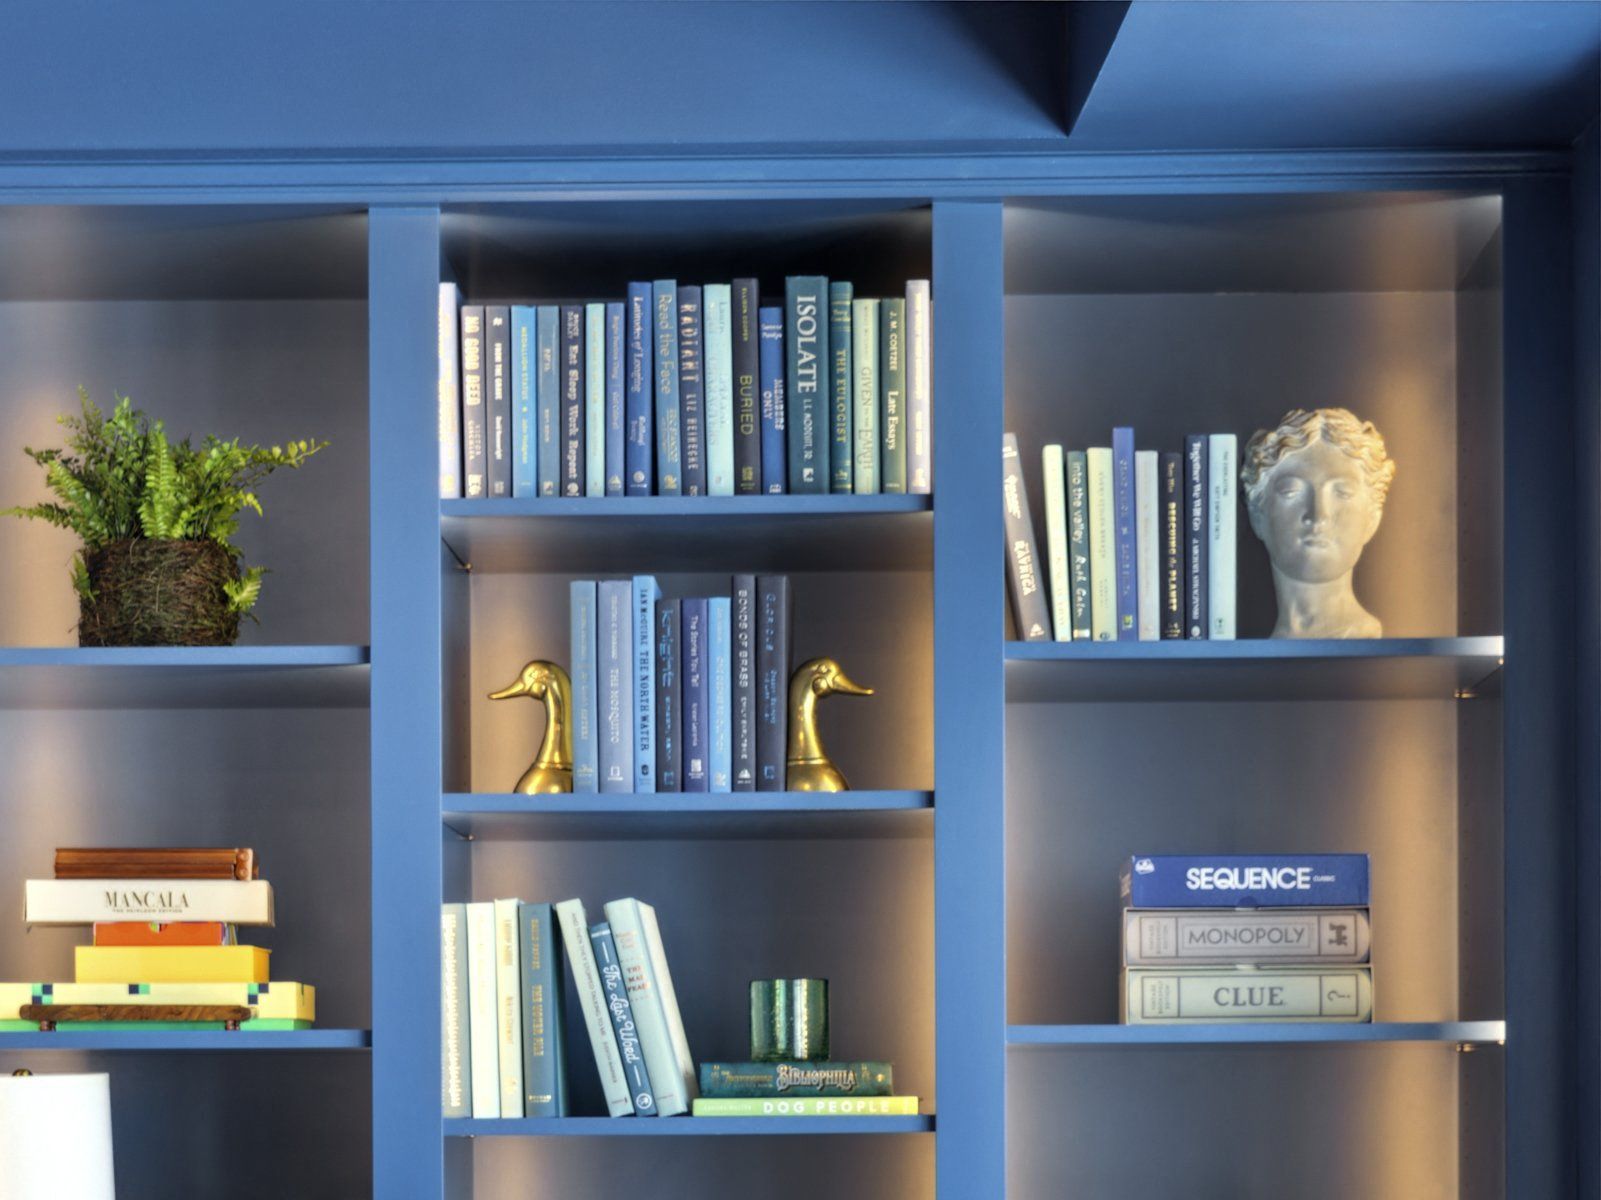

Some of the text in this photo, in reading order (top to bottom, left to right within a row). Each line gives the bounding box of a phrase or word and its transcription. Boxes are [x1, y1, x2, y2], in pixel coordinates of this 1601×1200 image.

[465, 338, 481, 370] GOOD
[631, 296, 644, 393] Latitudes of Longing
[658, 294, 675, 394] Read the Face
[680, 304, 699, 383] RADIANT
[796, 294, 818, 394] ISOLATE
[890, 310, 898, 372] J. M. COETZEE
[466, 374, 481, 406] DEED
[566, 344, 579, 479] Eat Sleep Work Repeat
[686, 394, 697, 412] LIZ
[740, 374, 753, 436] BURIED
[763, 390, 773, 419] ONLY
[774, 379, 785, 431] MEMBERS
[836, 348, 847, 443] THE EULOGIST
[858, 367, 872, 470] GIVEN EARTH
[885, 390, 899, 449] Late Essays
[1072, 462, 1084, 544] into the valley
[1190, 441, 1201, 531] Together We Will Go
[1168, 502, 1176, 555] RESCUING
[640, 588, 648, 605] IAN
[1075, 554, 1086, 618] Ruth Galm
[1168, 570, 1177, 612] PLANET
[691, 616, 699, 688] The Stories You Tell
[739, 590, 748, 688] BONDS OF BRASS
[609, 668, 620, 744] THE MOSQUITO
[640, 650, 649, 752] THE NORTH WATER
[106, 891, 190, 908] MANCALA
[1186, 867, 1311, 890] SEQUENCE
[1188, 928, 1305, 945] MONOPOLY
[532, 985, 544, 1003] THE
[603, 965, 637, 1064] The Last Word
[1214, 986, 1284, 1006] CLUE
[763, 1100, 805, 1114] DOG
[816, 1100, 890, 1113] PEOPLE
[776, 1064, 857, 1091] BIBLIOPHILIA
